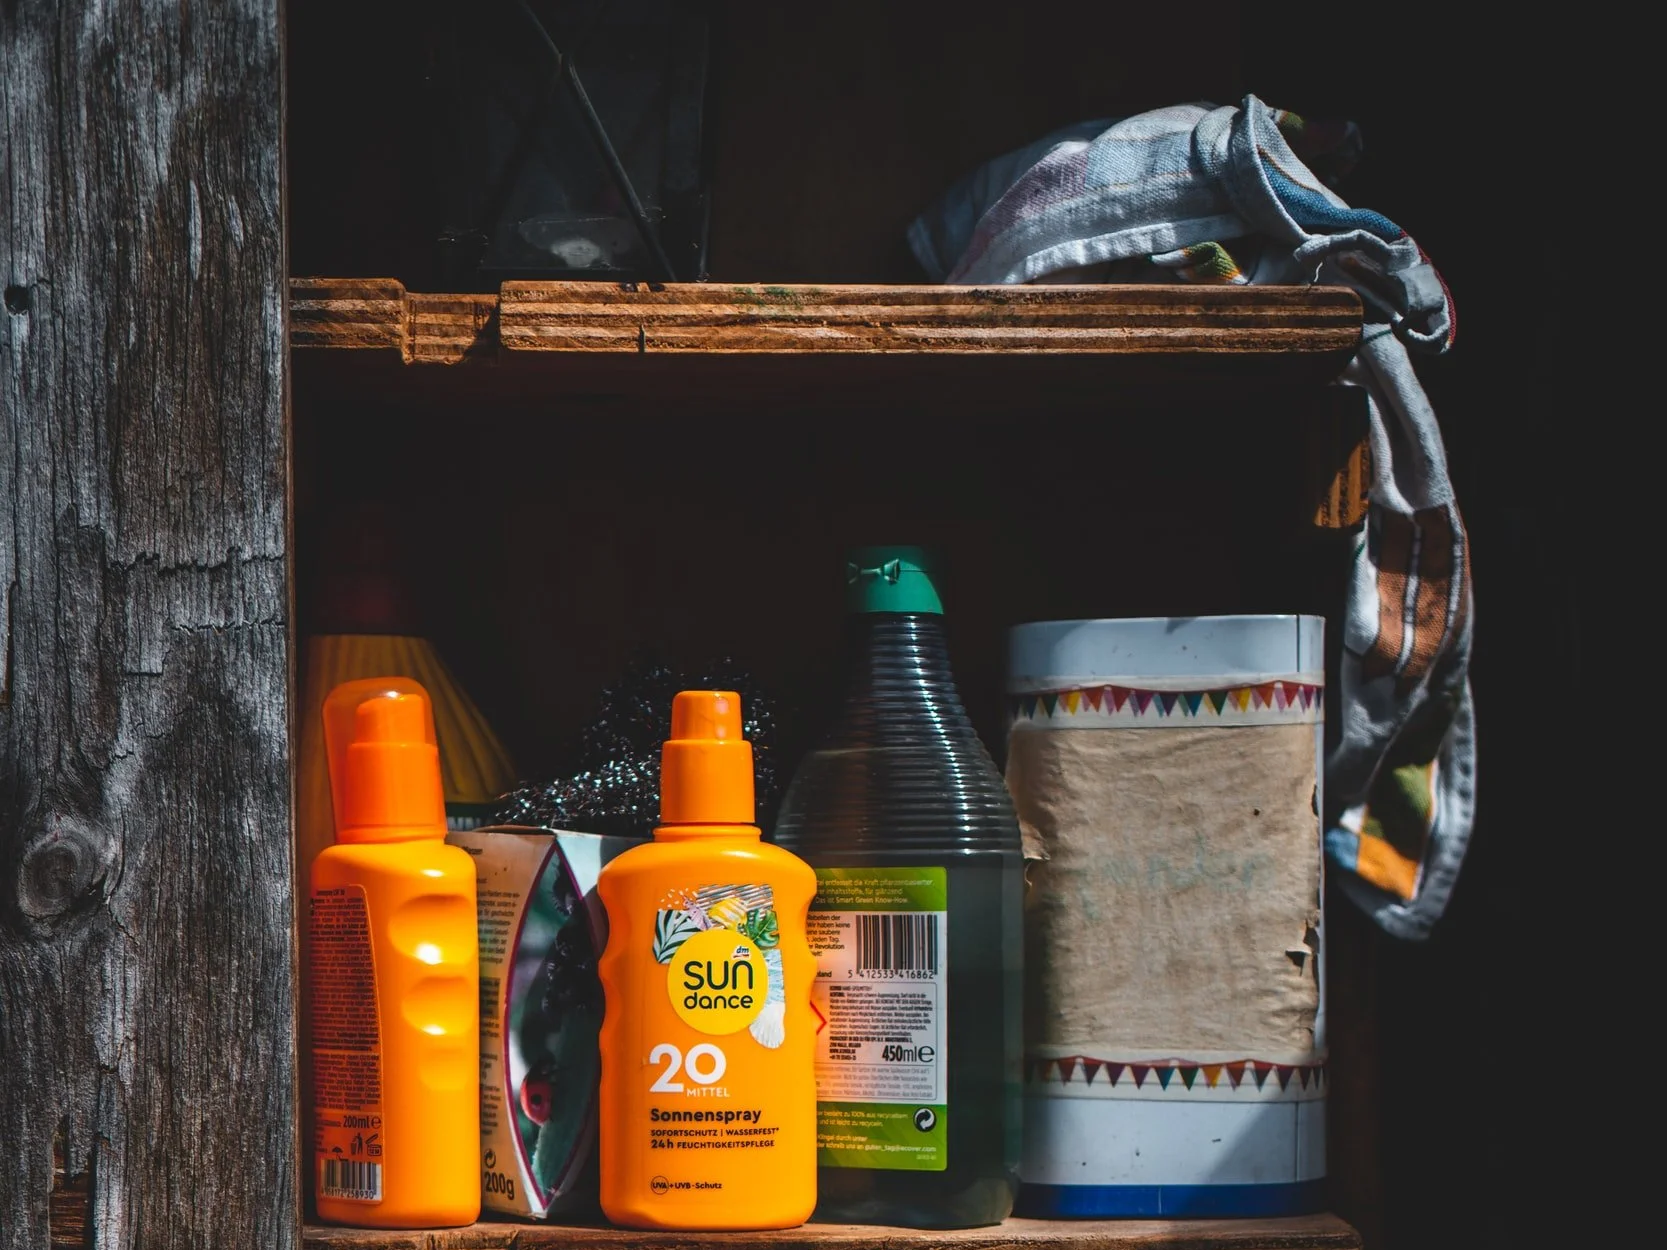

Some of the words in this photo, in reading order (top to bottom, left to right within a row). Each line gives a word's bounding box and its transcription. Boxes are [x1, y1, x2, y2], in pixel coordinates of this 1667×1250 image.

[736, 945, 749, 954] dm
[847, 969, 853, 979] 5
[859, 970, 894, 979] 412533
[899, 970, 935, 980] 416862
[683, 992, 753, 1010] dance
[649, 1043, 727, 1093] 20
[686, 1087, 730, 1097] MITTEL
[343, 1115, 370, 1128] 200ml
[650, 1108, 762, 1124] Sonnenspray
[651, 1129, 718, 1137] SOFORTSCHUTZ
[677, 1140, 775, 1149] FEUCHTIGKEITSPFLEGE
[485, 1172, 515, 1200] 200g
